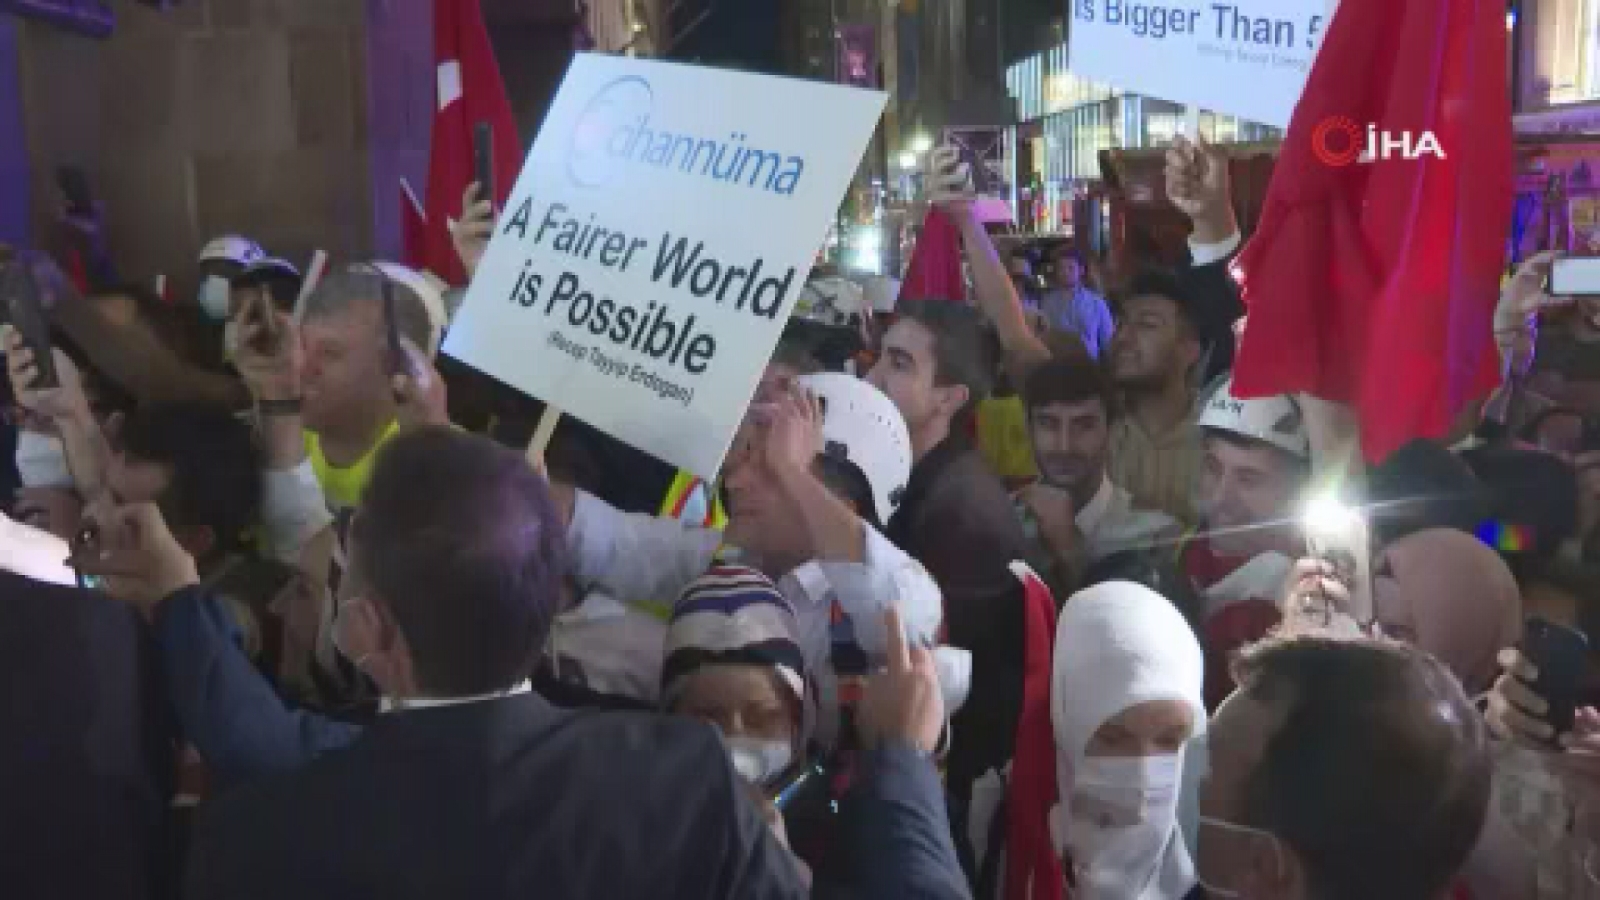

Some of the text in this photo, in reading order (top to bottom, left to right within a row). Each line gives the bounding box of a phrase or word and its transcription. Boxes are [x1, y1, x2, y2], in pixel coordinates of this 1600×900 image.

[1105, 0, 1200, 38] Bigger
[1211, 4, 1295, 47] Than
[503, 195, 796, 319] A Fairer World
[509, 258, 716, 374] is Possible
